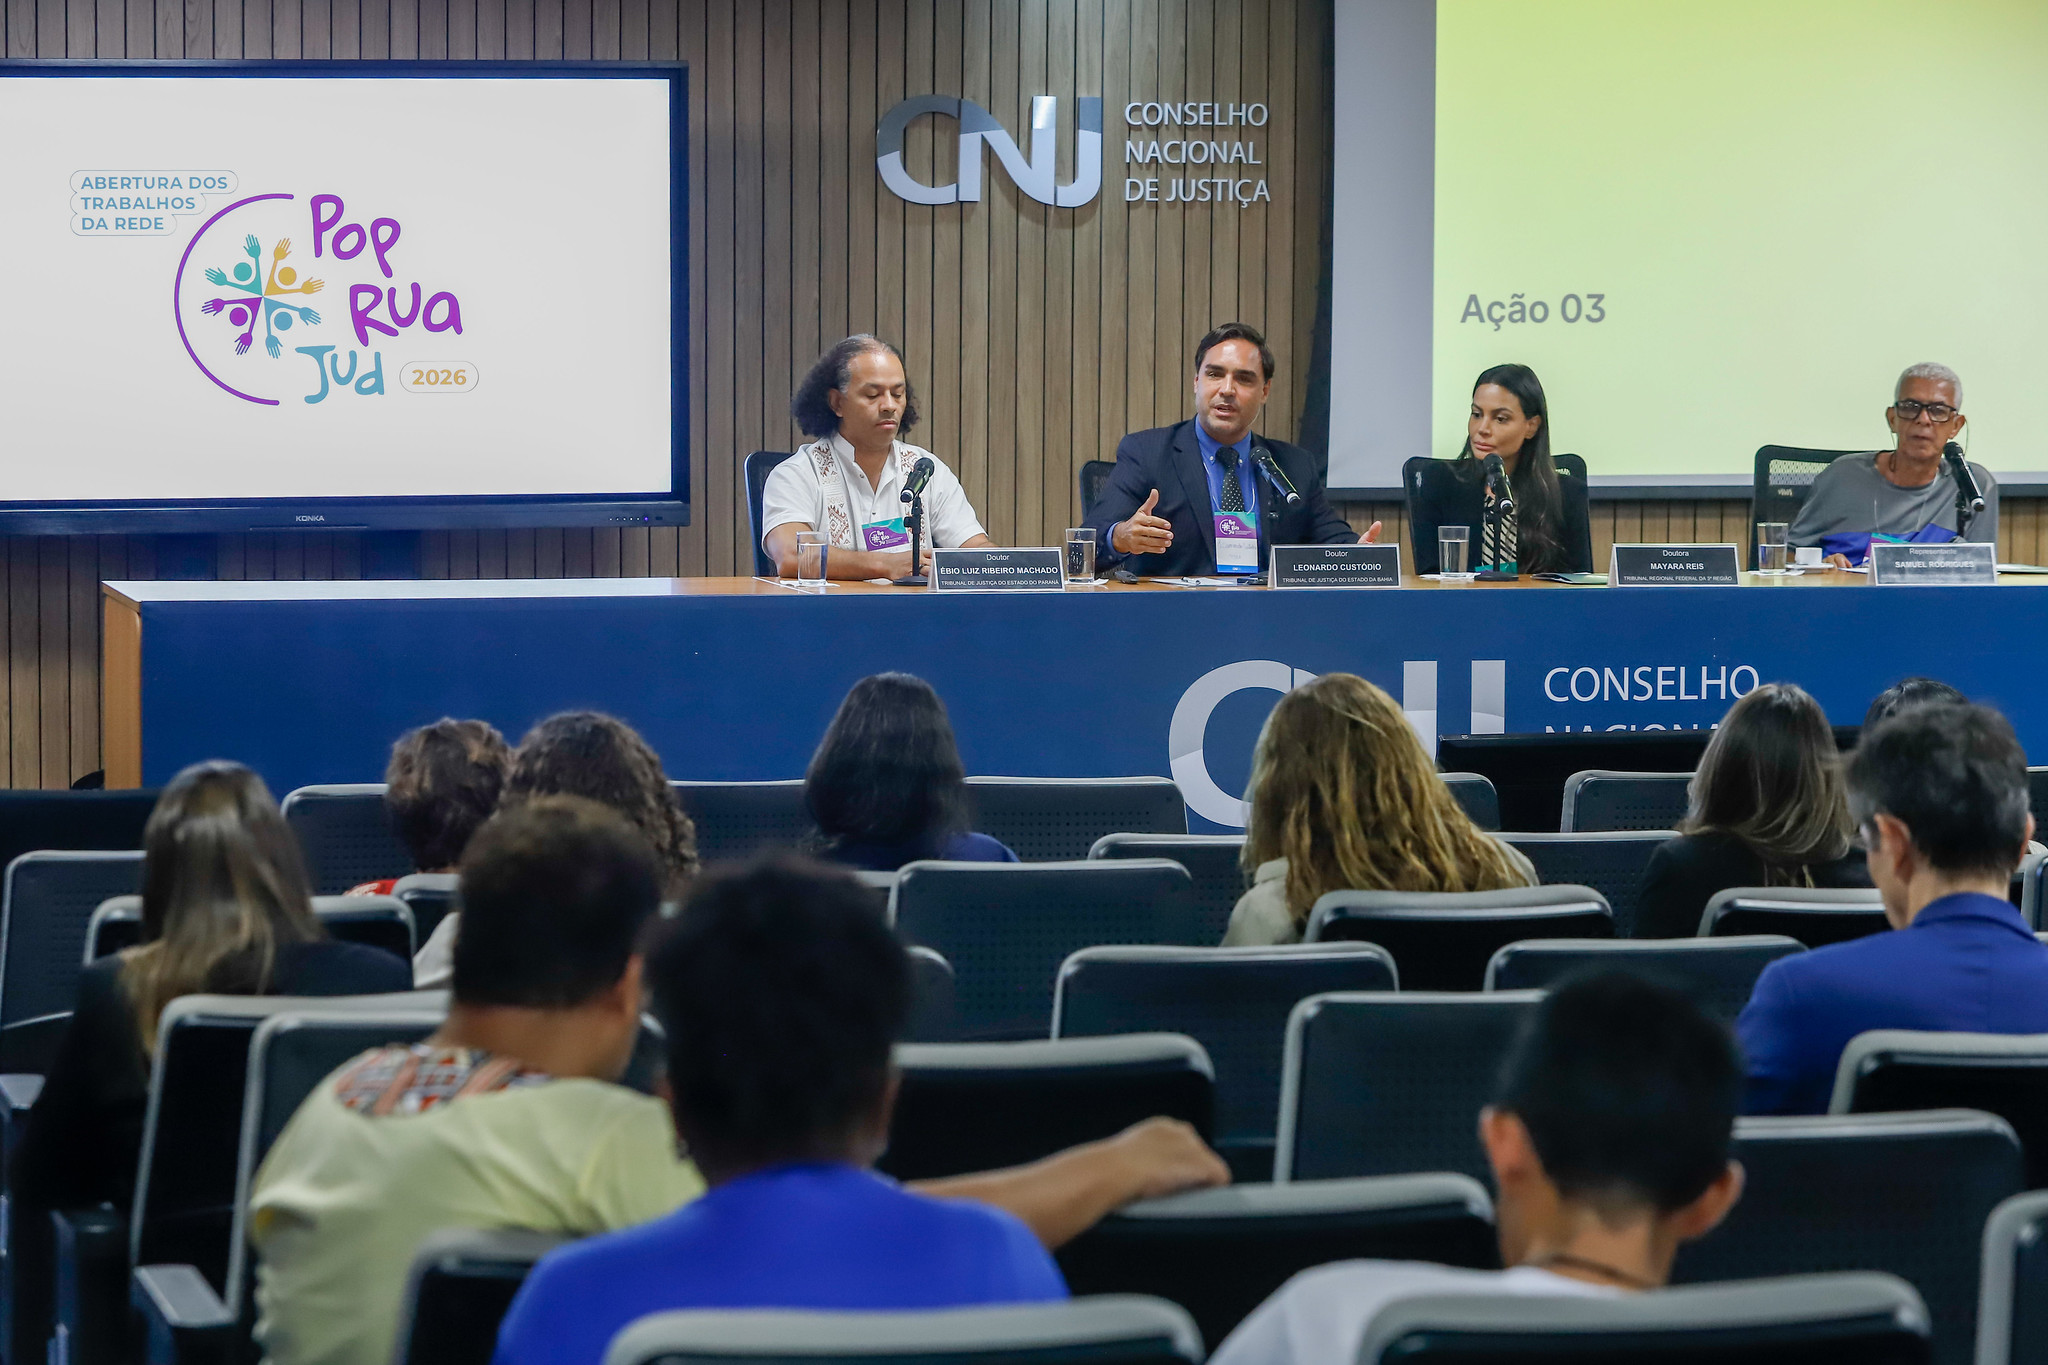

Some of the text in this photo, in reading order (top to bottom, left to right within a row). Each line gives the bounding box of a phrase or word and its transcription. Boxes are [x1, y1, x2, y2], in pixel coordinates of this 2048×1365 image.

[1124, 102, 1269, 127] CONSELHO
[876, 94, 1103, 208] CNJ
[1125, 140, 1262, 164] NACIONAL
[80, 176, 228, 190] ABERTURA DOS
[1125, 178, 1271, 208] DE JUSTIÇA
[80, 196, 196, 210] TRABALHOS
[81, 217, 164, 230] DA REDE
[310, 193, 401, 279] Pop
[1460, 292, 1606, 332] Ação 03
[294, 344, 385, 404] Jud
[412, 369, 467, 386] 2026
[986, 553, 1010, 561] Doutor
[1325, 549, 1348, 557] Doutor
[1662, 549, 1690, 557] Doutora
[940, 566, 1058, 575] ÉBIO LUIZ RIBEIRO MACHADO
[1293, 562, 1382, 571] LEONARDO CUSTÓDIO
[1650, 562, 1704, 570] MAYARA REIS
[1895, 560, 1975, 568] SAMUEL RODRIGUES
[1543, 664, 1760, 702] CONSELHO
